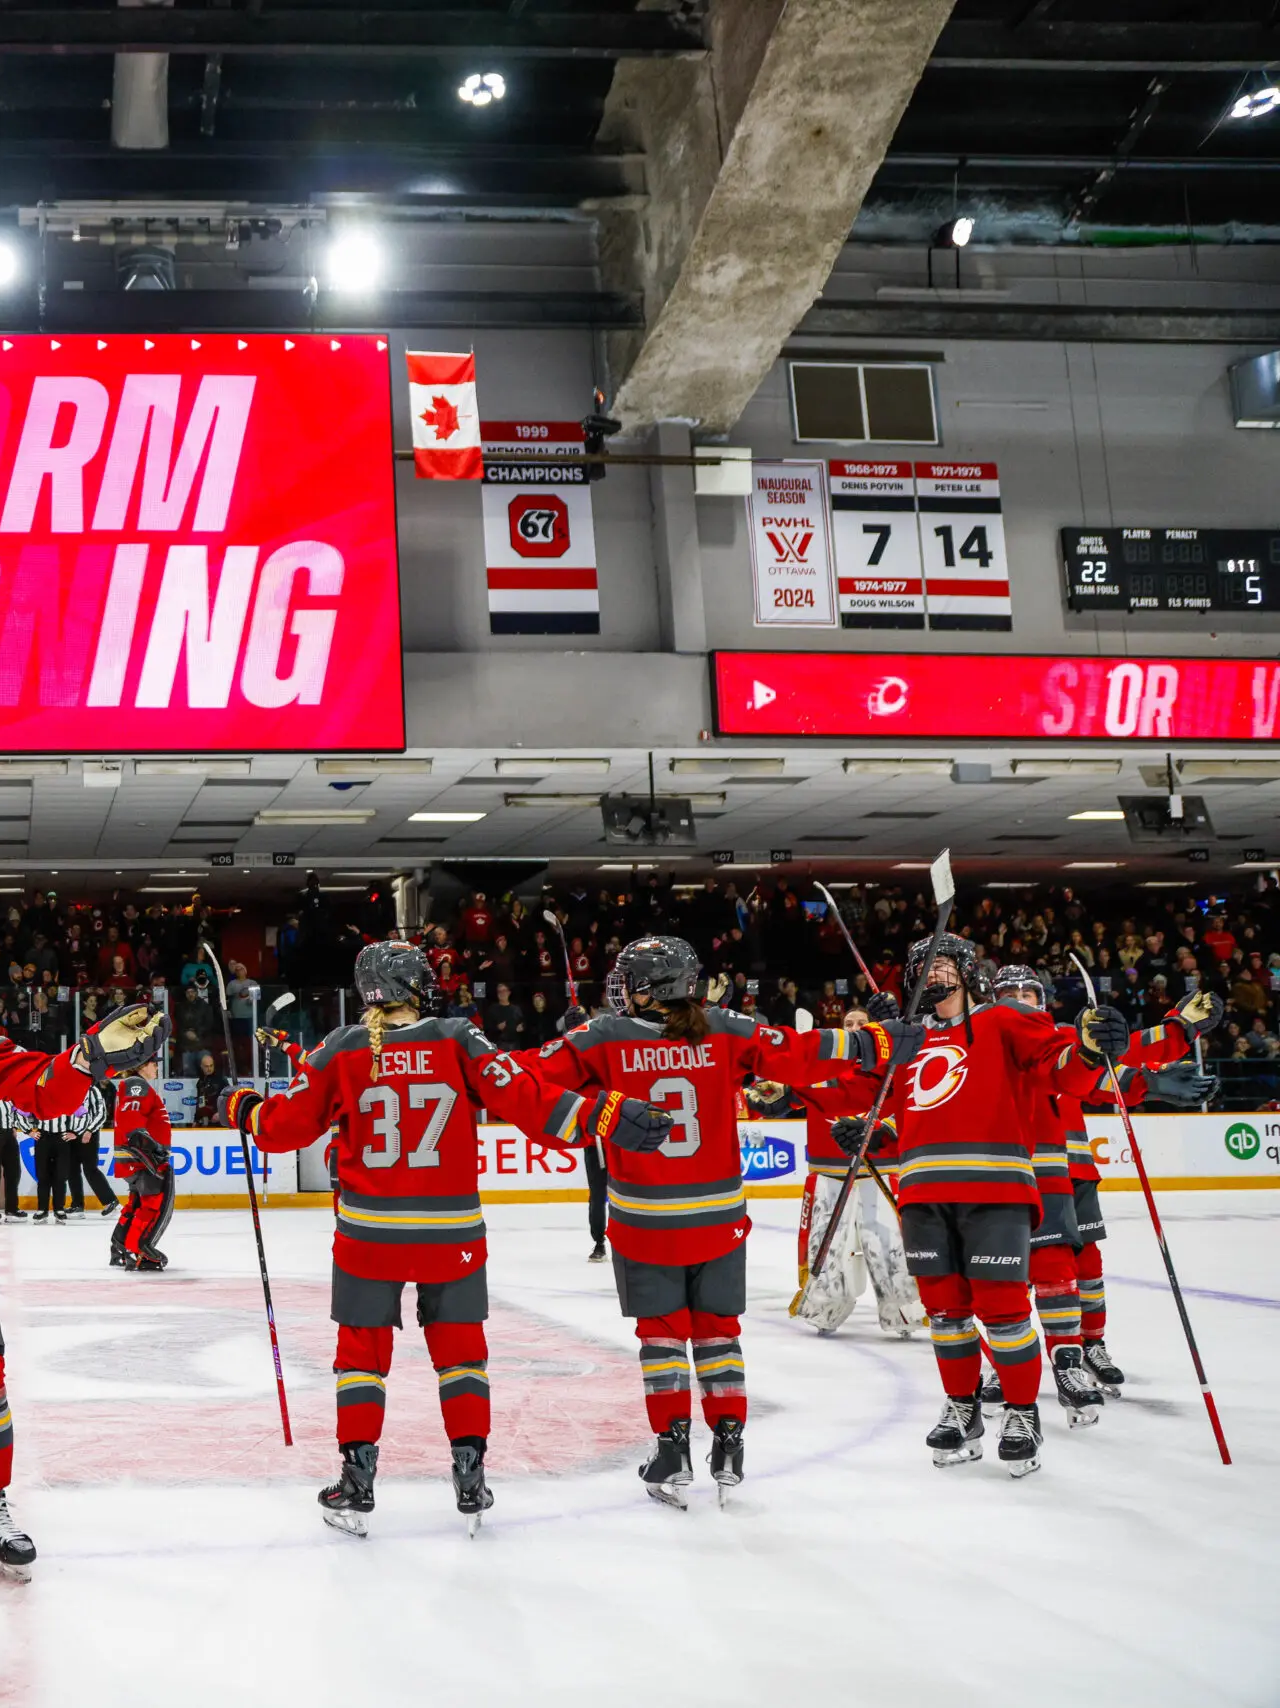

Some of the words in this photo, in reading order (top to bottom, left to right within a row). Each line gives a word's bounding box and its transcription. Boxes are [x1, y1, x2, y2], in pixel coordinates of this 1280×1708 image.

[516, 426, 548, 437] 1999
[487, 467, 583, 481] CHAMPIONS
[757, 478, 813, 491] INAUGURAL
[841, 481, 869, 490] DENIS
[870, 482, 904, 491] POTVIN
[934, 484, 963, 492] PETER
[965, 484, 982, 492] LEE
[767, 492, 806, 504] SEASON
[762, 517, 815, 528] PWHL
[1123, 530, 1151, 539] PLAYER
[1166, 530, 1198, 540] PENALTY
[862, 524, 892, 566] 7
[1080, 536, 1103, 545] SHOTS
[934, 525, 993, 568] 14
[1076, 546, 1088, 554] ON
[1089, 546, 1109, 555] GOAL
[768, 567, 817, 576] OTTAWA
[1081, 561, 1107, 583] 22
[853, 581, 908, 592] 1974-1977
[1075, 585, 1095, 595] TEAM
[1096, 585, 1119, 595] FOULS
[1246, 576, 1262, 604] 5
[773, 588, 815, 607] 2024
[1130, 598, 1158, 607] PLAYER
[1168, 598, 1182, 607] FLS
[1184, 598, 1211, 607] POINTS
[850, 600, 877, 608] DOUG
[879, 600, 915, 608] WILSON
[1042, 662, 1237, 737] STORM
[219, 856, 232, 864] 06
[275, 856, 288, 864] 07
[620, 1043, 715, 1073] LAROCQUE
[481, 1051, 525, 1088] 37
[596, 1090, 622, 1136] BAUE
[358, 1082, 458, 1169] 37
[97, 1147, 272, 1175] FDUEL
[477, 1139, 577, 1174] GERS
[740, 1144, 789, 1177] yale
[1078, 1220, 1105, 1231] BAUE
[971, 1255, 1020, 1265] BAUER
